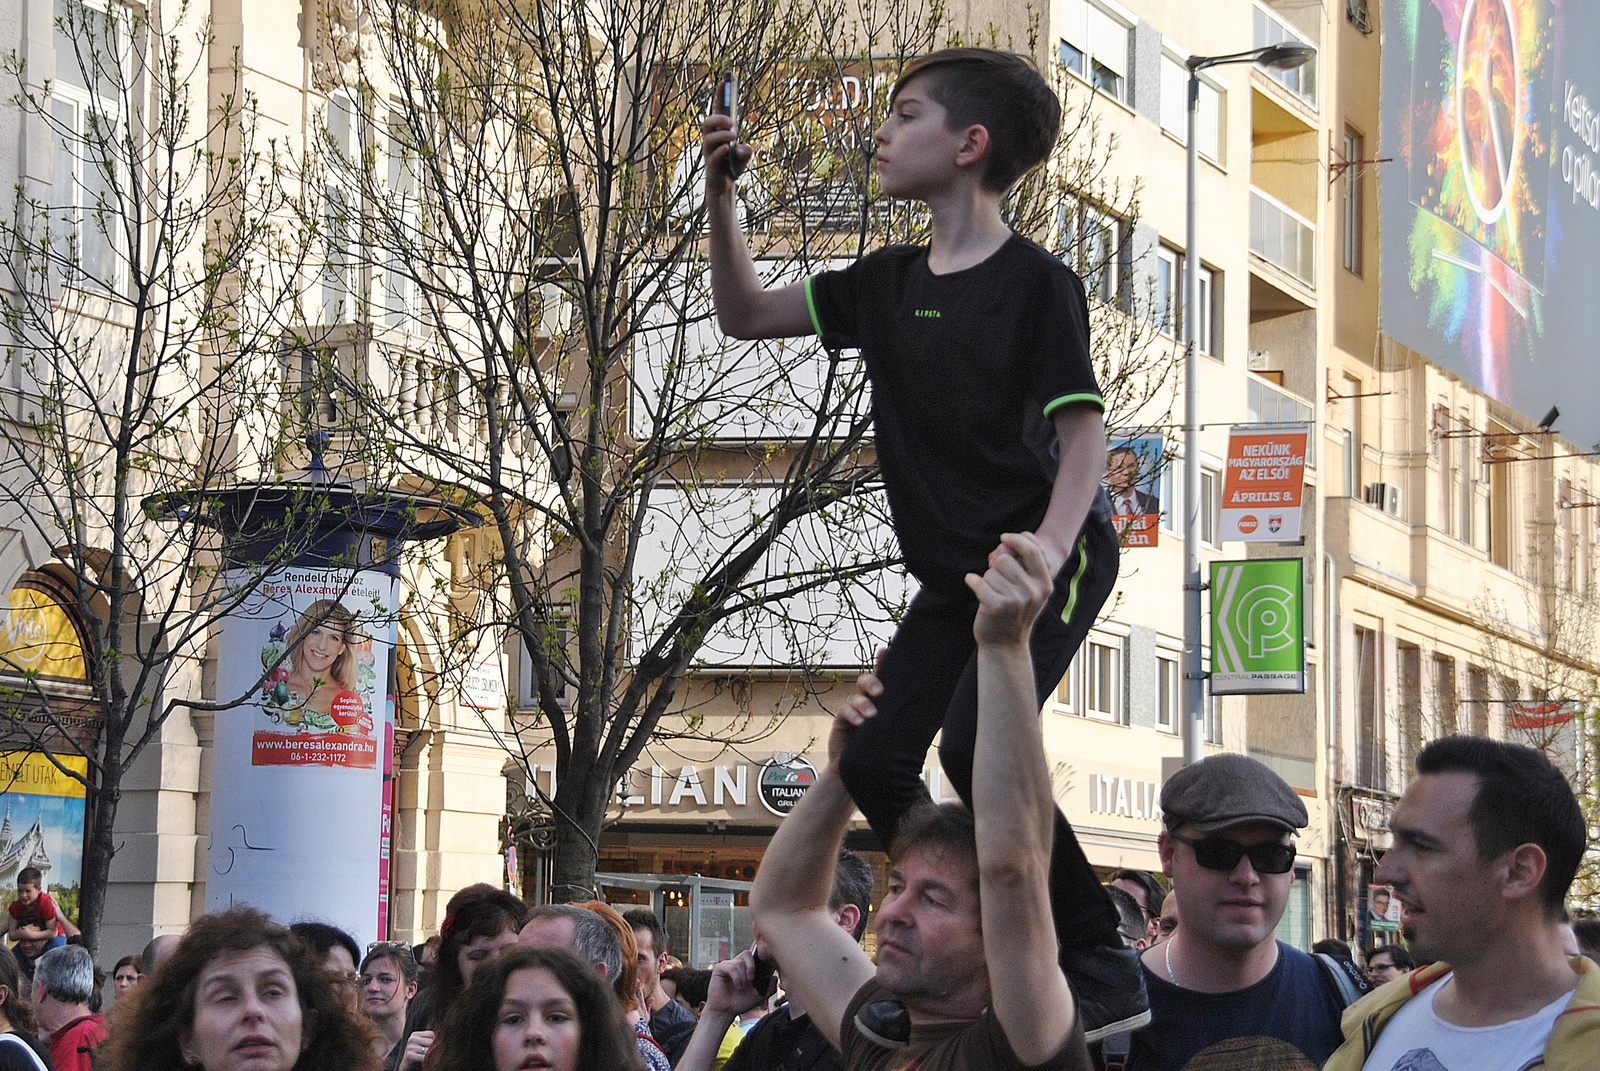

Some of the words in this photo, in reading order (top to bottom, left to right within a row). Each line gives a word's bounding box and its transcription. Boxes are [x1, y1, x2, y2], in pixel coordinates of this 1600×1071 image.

[1243, 442, 1291, 457] NEKÜNK
[1228, 454, 1304, 468] MAGYARORSZÁG
[1239, 469, 1255, 481] AZ
[1257, 465, 1290, 480] ELSŐ!
[1231, 491, 1279, 503] ÁPRILIS
[1282, 491, 1293, 501] 8.
[295, 584, 349, 596] Alexandra
[6, 616, 42, 646] Vista
[256, 739, 374, 753] www.beresalexandra.hu
[290, 752, 347, 762] 06-1-232-1172
[32, 764, 58, 785] UTAK
[525, 763, 747, 806] ITLIAN
[772, 787, 806, 797] ITALIAN
